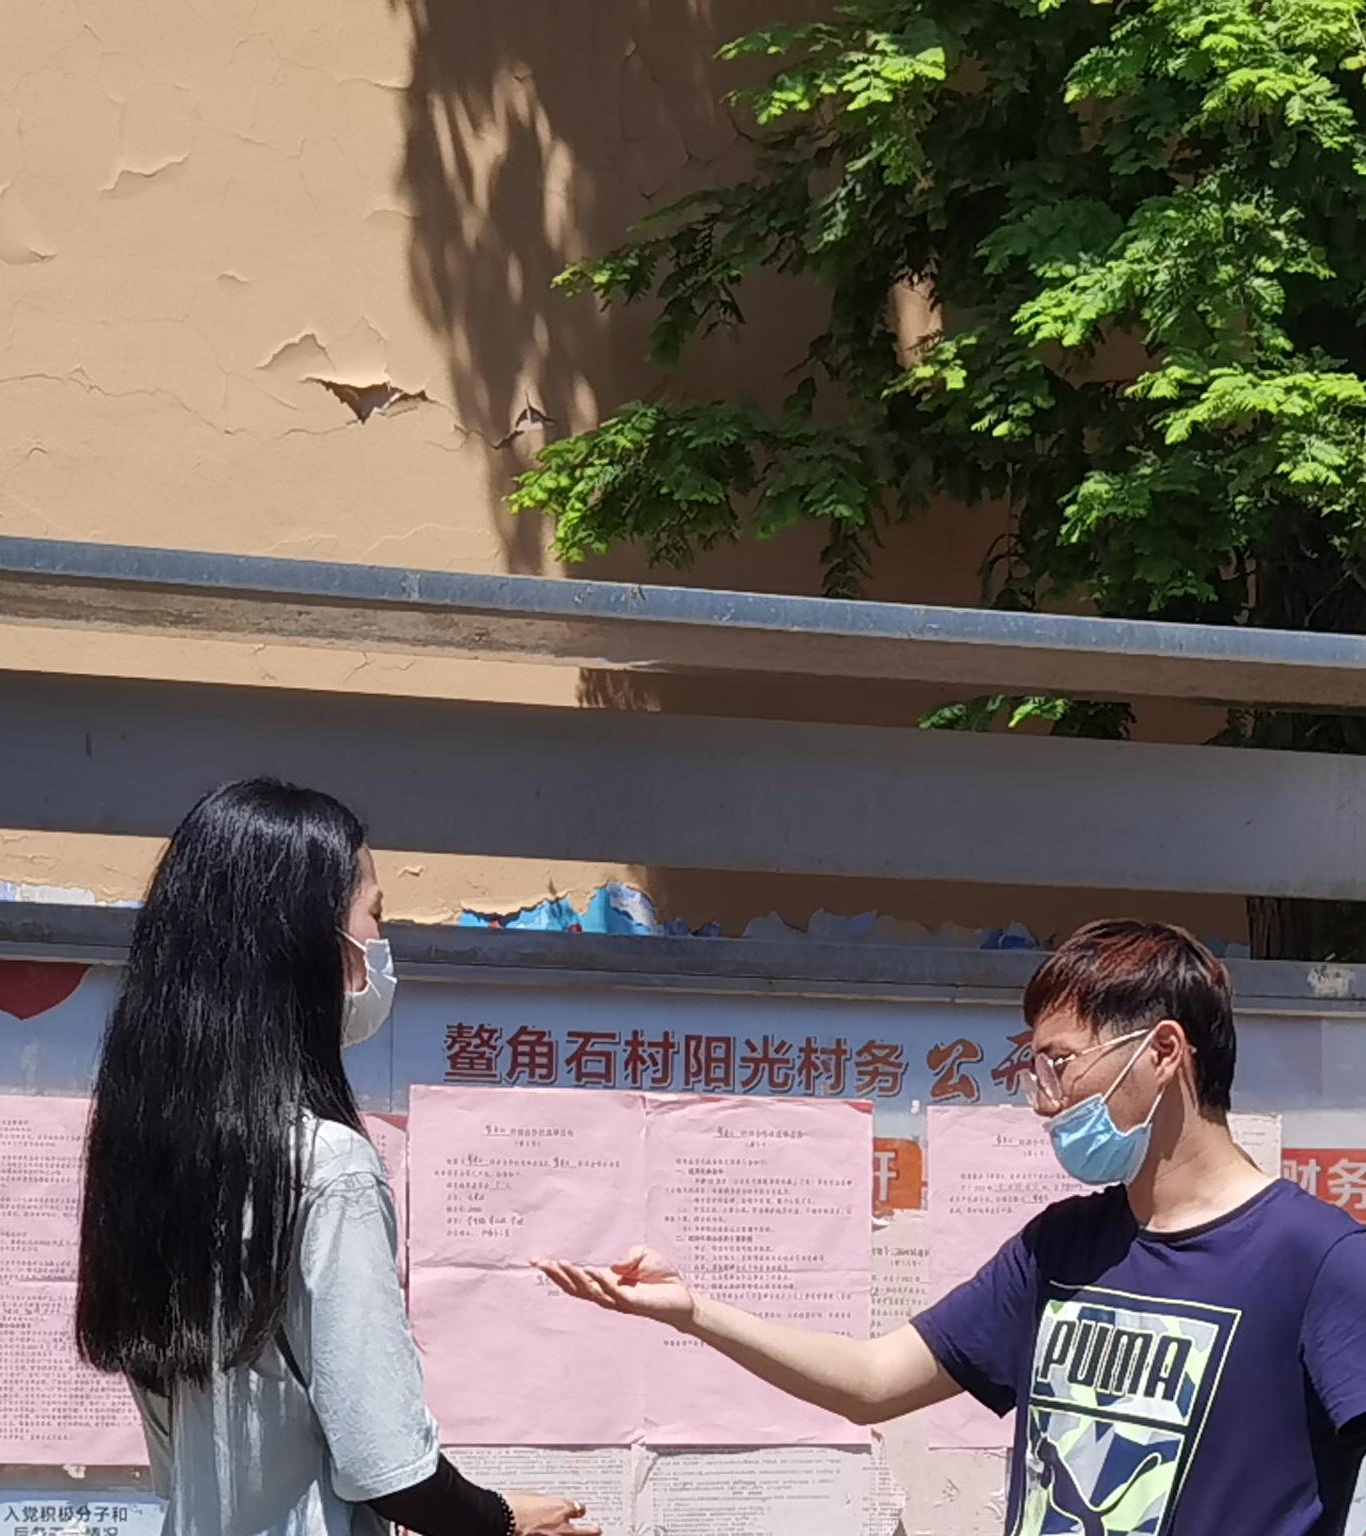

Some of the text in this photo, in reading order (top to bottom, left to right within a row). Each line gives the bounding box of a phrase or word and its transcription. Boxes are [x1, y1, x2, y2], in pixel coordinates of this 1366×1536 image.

[442, 1021, 908, 1098] 鳌角石村阳光村务
[1038, 1319, 1194, 1402] PUMA
[4, 1505, 129, 1523] 入党积极分子和
